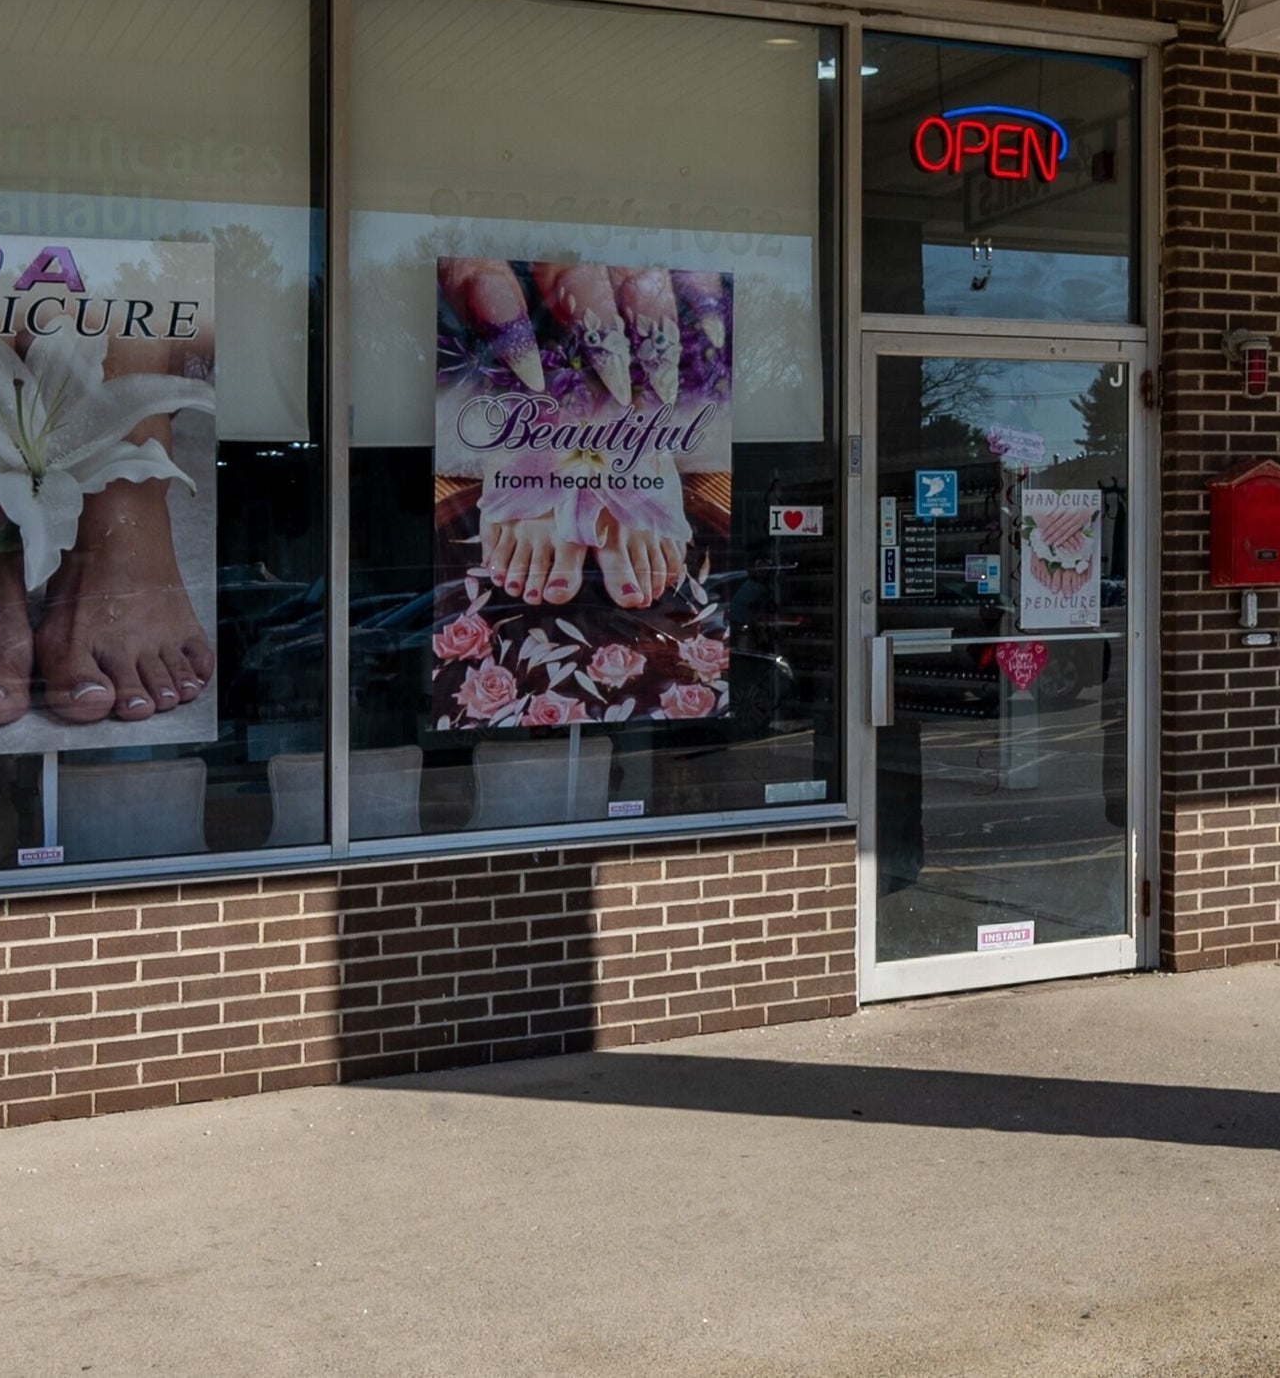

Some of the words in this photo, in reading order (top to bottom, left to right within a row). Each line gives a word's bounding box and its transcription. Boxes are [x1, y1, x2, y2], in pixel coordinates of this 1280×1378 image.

[915, 115, 1059, 183] OPEN
[1109, 363, 1123, 388] J
[455, 392, 718, 475] Beautiful
[494, 470, 544, 490] from
[550, 472, 602, 490] head
[608, 473, 629, 490] to
[632, 473, 665, 490] toe
[1024, 493, 1100, 508] MANICURE
[771, 510, 782, 531] I
[1024, 595, 1098, 610] PEDICURE
[984, 930, 1027, 943] INSTANT
